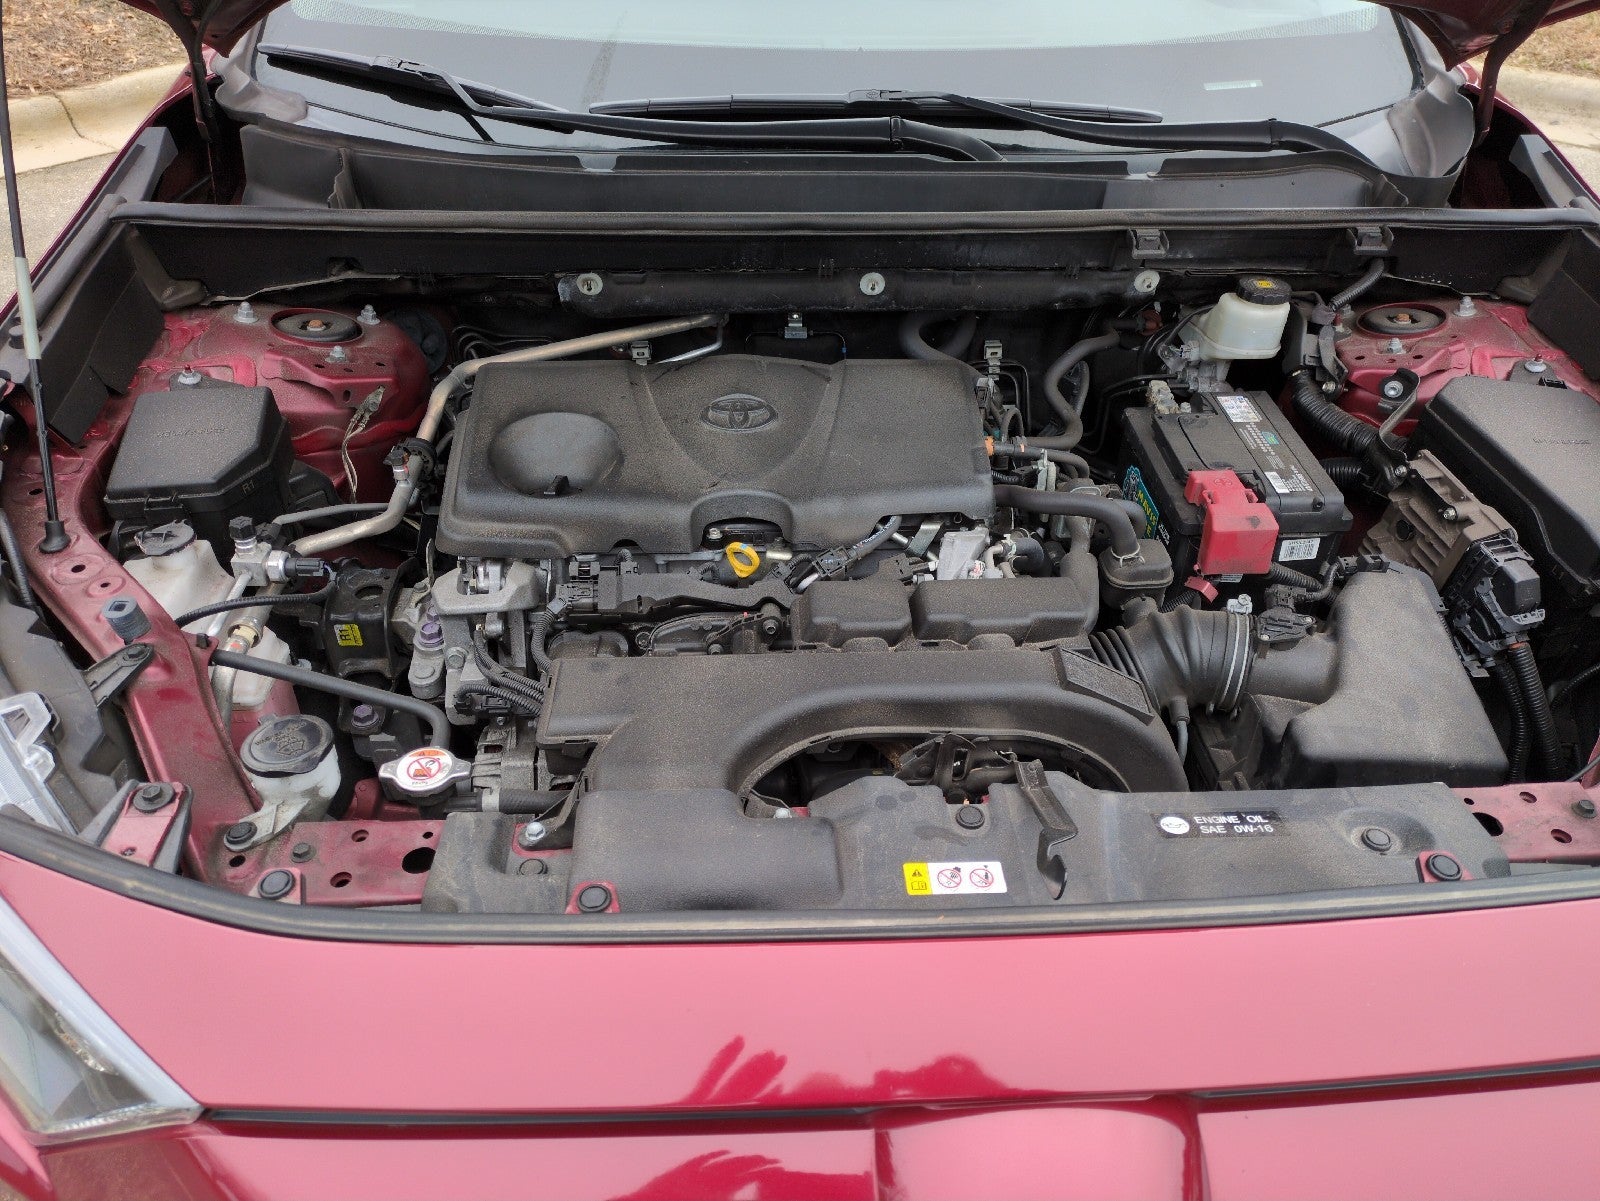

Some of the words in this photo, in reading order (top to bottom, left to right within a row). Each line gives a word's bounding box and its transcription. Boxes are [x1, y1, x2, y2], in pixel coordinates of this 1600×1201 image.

[1193, 815, 1241, 824] ENGINE
[1245, 815, 1269, 823] OIL
[1200, 825, 1227, 834] SAE
